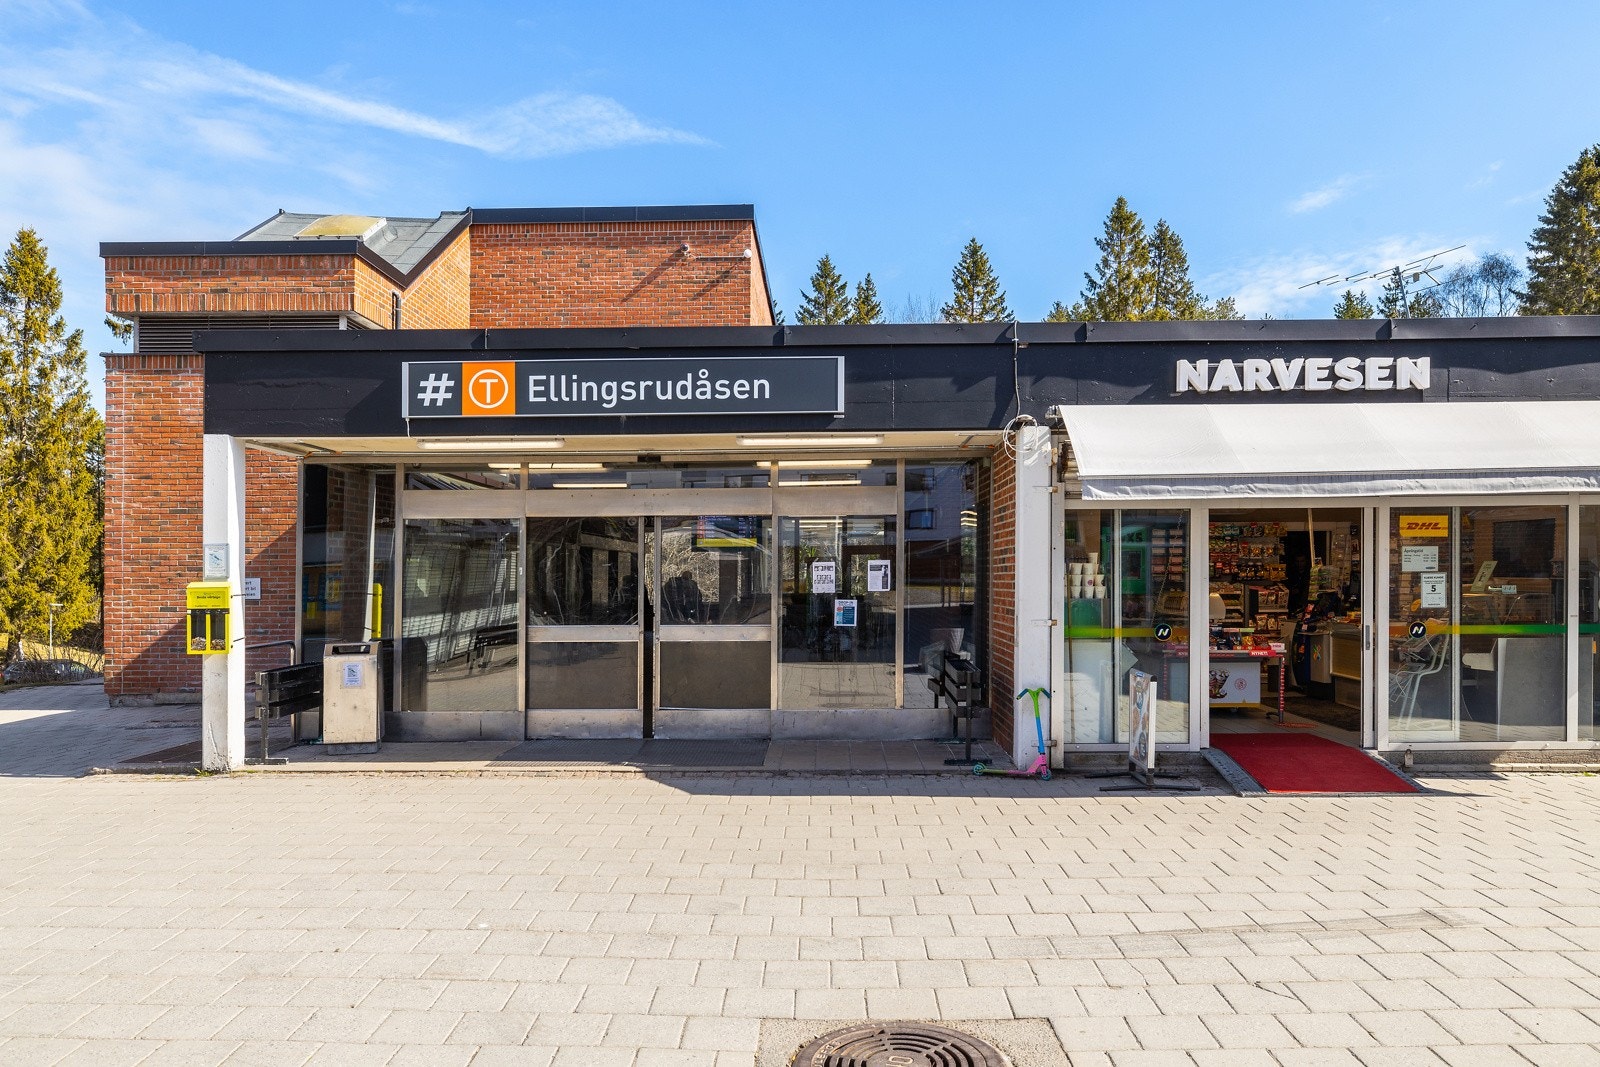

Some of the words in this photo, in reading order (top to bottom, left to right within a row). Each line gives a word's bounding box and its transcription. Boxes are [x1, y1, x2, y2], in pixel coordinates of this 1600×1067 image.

[1176, 356, 1431, 392] NARVESEN
[528, 368, 770, 409] Ellingsrudåsen
[1405, 522, 1442, 530] DHL
[1430, 584, 1437, 592] 5
